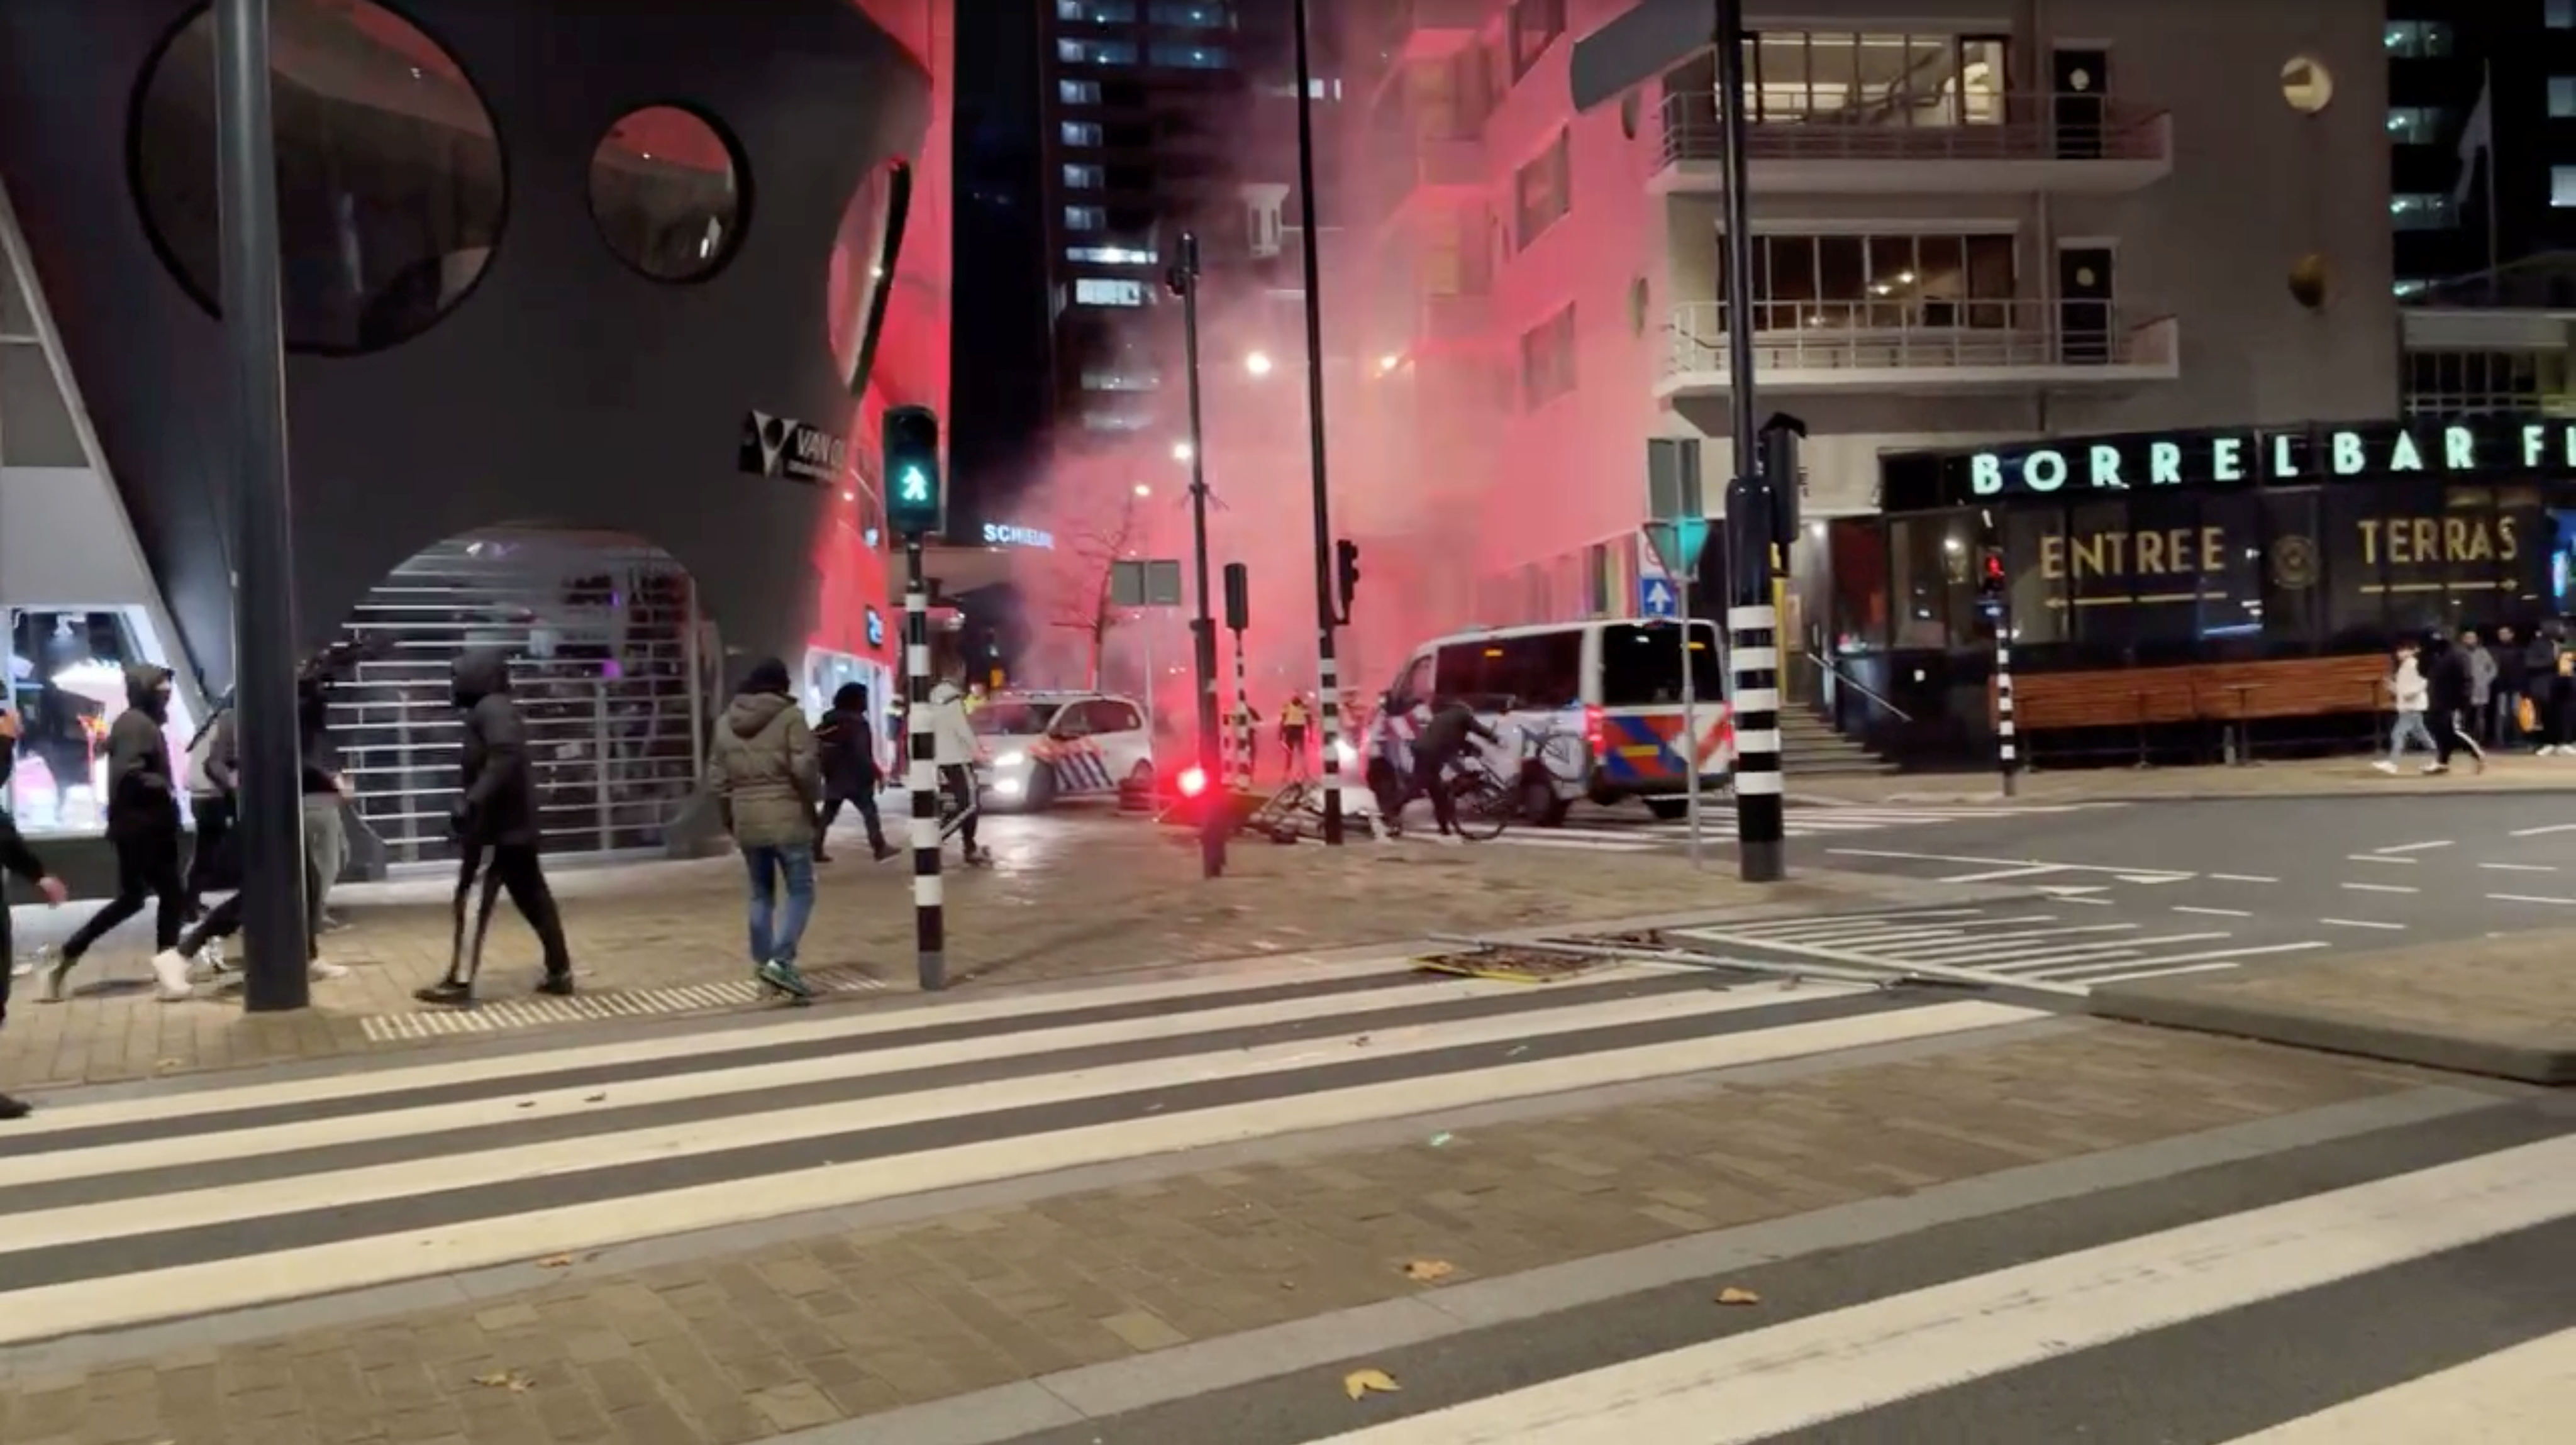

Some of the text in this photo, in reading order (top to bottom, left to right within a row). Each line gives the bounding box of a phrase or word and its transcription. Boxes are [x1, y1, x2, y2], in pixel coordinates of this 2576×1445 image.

[797, 428, 831, 463] VAN
[2040, 526, 2224, 580] ENTREE
[2358, 516, 2518, 564] TERRAS
